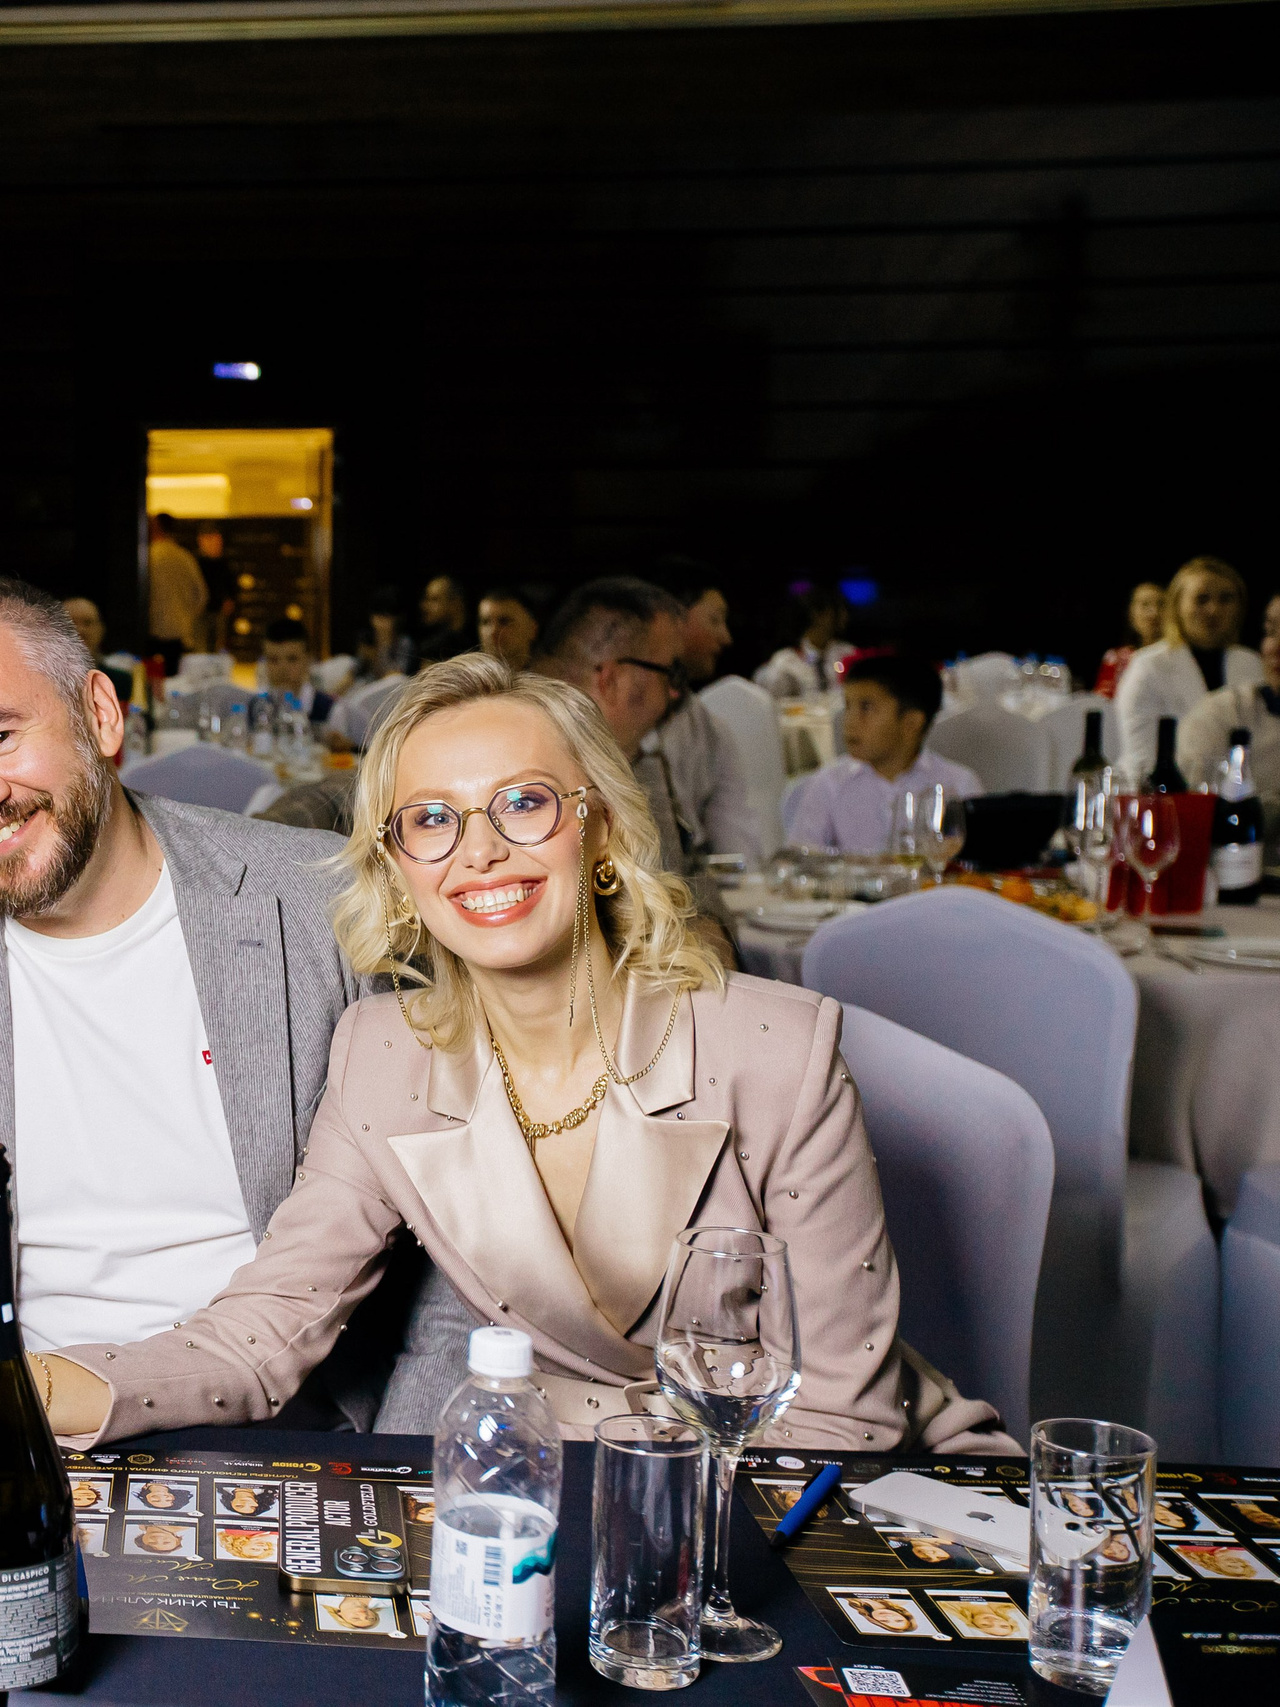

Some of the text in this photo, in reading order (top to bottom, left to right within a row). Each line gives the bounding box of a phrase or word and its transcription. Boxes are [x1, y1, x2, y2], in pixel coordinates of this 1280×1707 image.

[170, 1469, 248, 1477] РЕГИОНАЛЬНОГО
[323, 1500, 352, 1527] ACTOR
[360, 1483, 379, 1527] GOLDFIELD
[285, 1481, 322, 1573] GENERAL PRODUCER
[1, 1566, 50, 1583] DI CASPICO
[91, 1596, 240, 1609] ТЫ УНИКАЛЬНА
